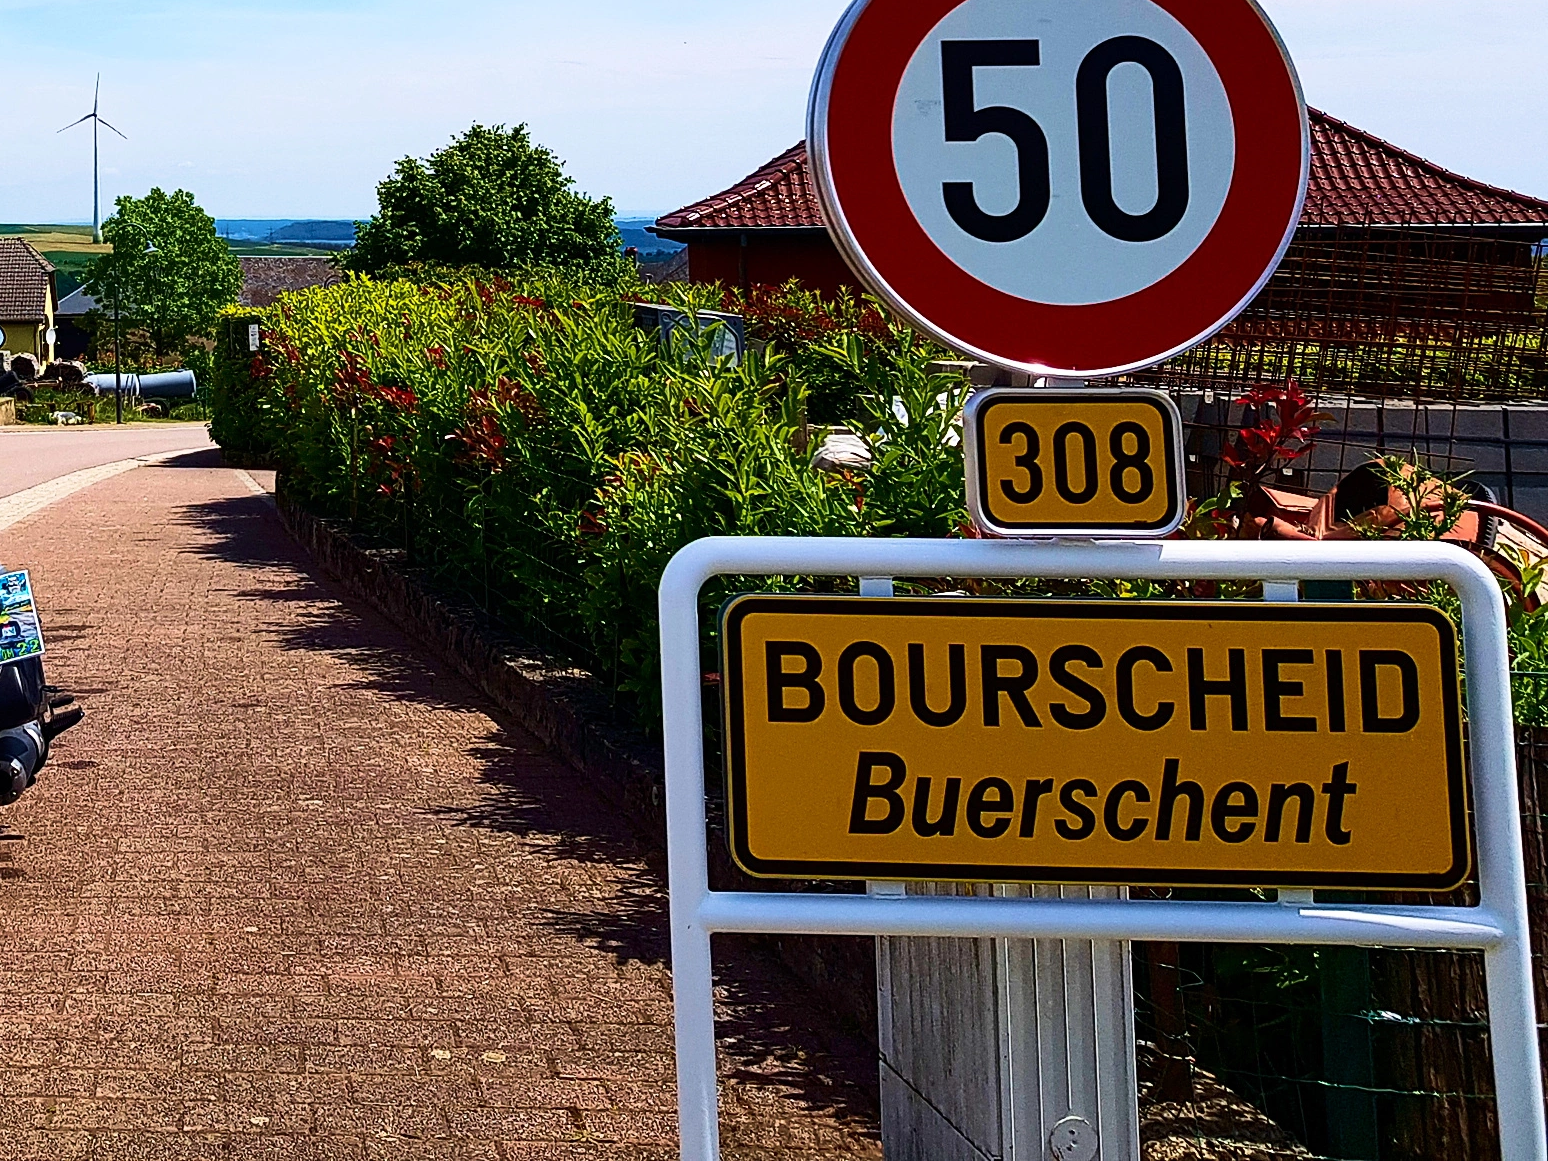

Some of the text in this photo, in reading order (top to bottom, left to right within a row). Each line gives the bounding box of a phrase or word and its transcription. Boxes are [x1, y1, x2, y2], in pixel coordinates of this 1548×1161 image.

[940, 35, 1190, 243] 50
[998, 420, 1154, 505] 308
[764, 640, 1421, 734] BOURSCHEID
[847, 751, 1358, 846] Buerschent
